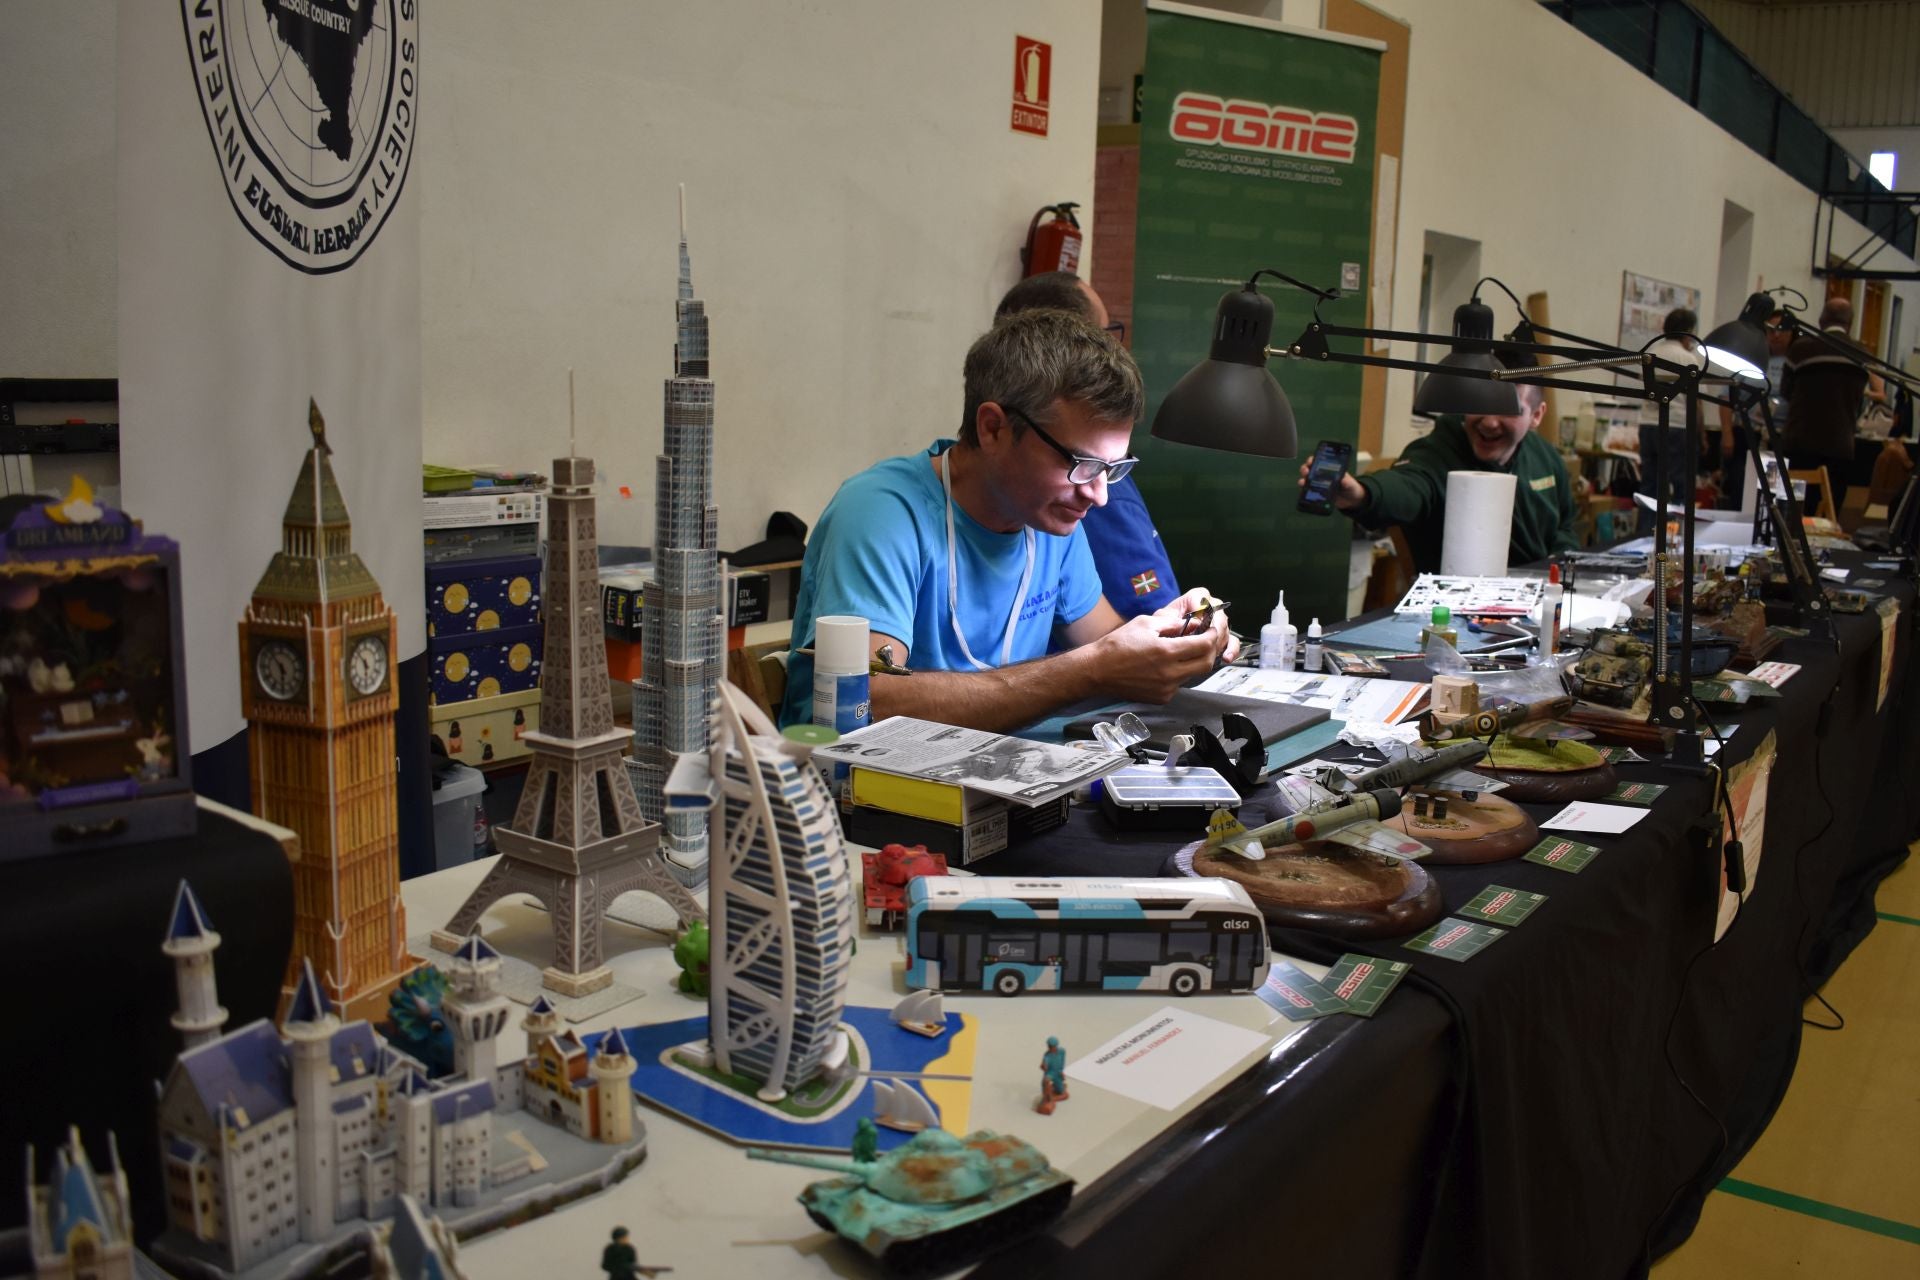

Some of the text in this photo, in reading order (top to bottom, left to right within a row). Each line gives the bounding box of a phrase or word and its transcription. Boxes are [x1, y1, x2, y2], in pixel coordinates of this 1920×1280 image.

[311, 4, 352, 34] COUNTRY
[371, 38, 415, 210] SOCIETY
[243, 174, 372, 255] EUSKAL HERRIA
[1223, 919, 1250, 930] alsa
